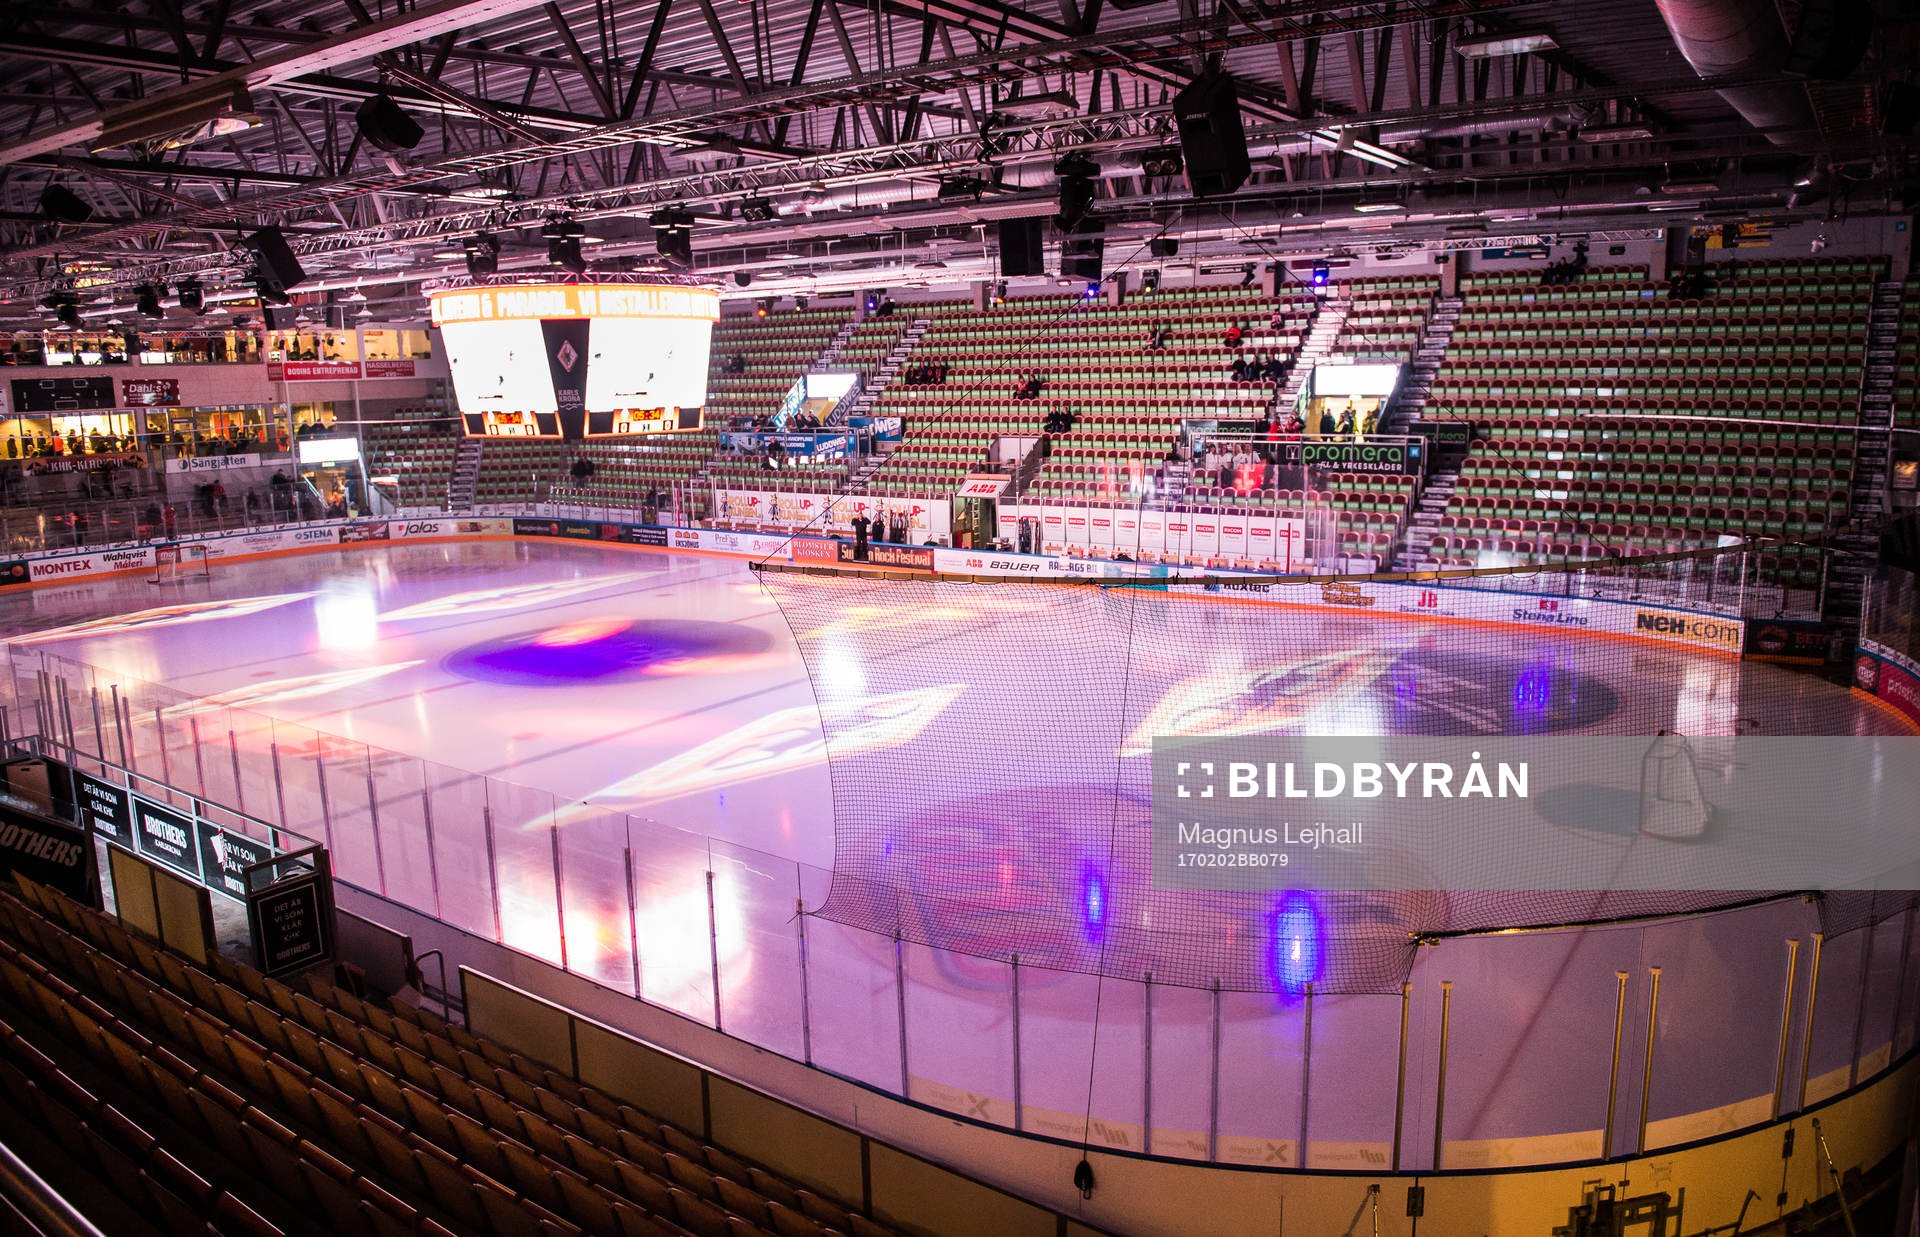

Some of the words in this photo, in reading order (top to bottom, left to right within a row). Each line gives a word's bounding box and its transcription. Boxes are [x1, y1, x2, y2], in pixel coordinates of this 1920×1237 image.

[312, 366, 358, 375] ENTREPRENAD
[633, 409, 661, 421] 05:34
[1302, 445, 1402, 465] promera
[191, 455, 247, 472] Sängjätten
[966, 484, 998, 494] ABB
[303, 529, 333, 540] STENA
[404, 521, 439, 537] jalas
[102, 550, 148, 563] Wahlqvist
[965, 558, 983, 568] ABB
[33, 559, 92, 577] MONTEX
[1417, 590, 1438, 608] JB
[1512, 608, 1555, 623] Stena
[1556, 612, 1588, 626] Line
[144, 813, 187, 849] BROTHERS
